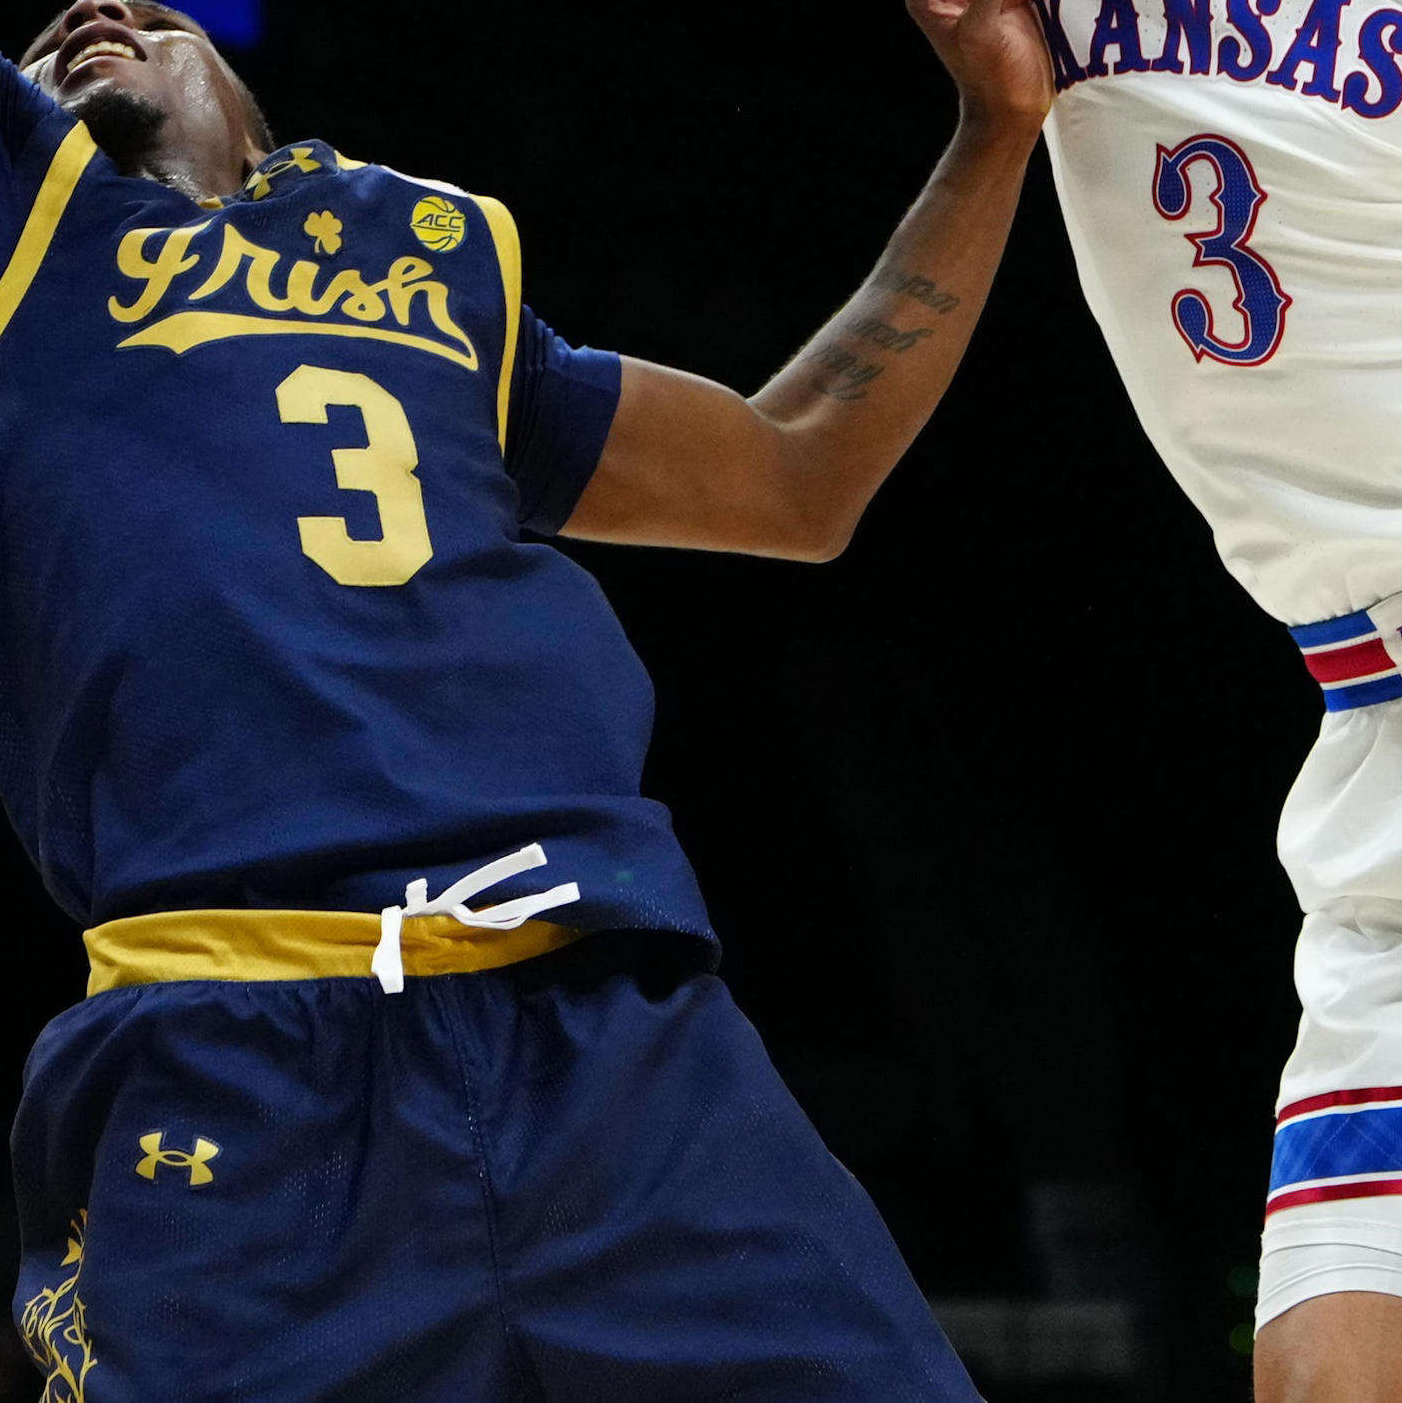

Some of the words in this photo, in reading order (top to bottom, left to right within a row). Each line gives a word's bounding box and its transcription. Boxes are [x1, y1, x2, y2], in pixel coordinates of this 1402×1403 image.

[108, 220, 479, 371] Irish
[1152, 133, 1293, 367] 3
[276, 364, 433, 587] 3
